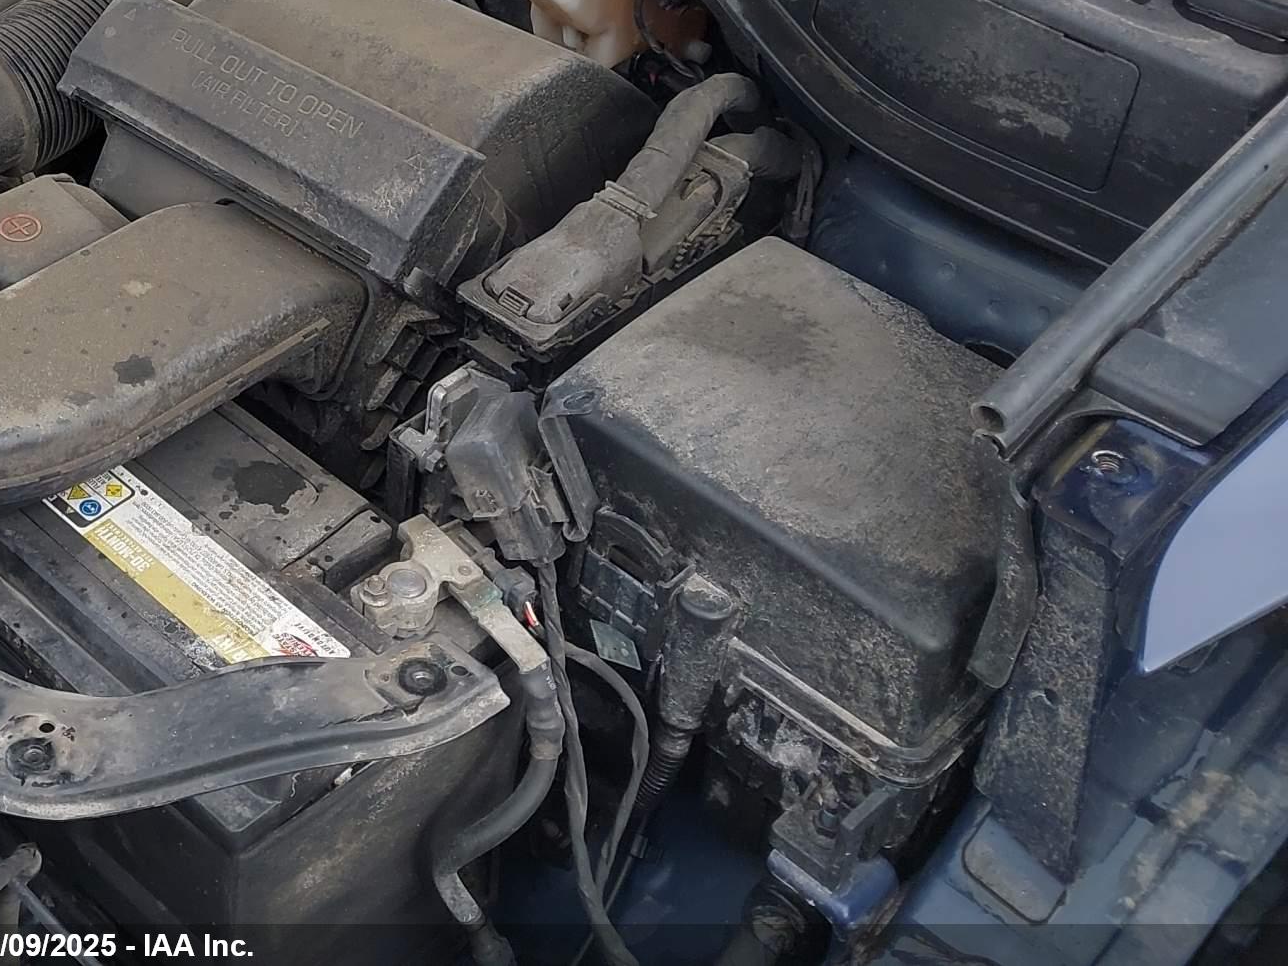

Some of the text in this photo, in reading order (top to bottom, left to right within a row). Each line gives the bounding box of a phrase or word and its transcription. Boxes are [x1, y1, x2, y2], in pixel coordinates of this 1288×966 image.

[169, 28, 365, 140] PULL OUT TO OPEN
[94, 525, 151, 572] 30-MONTH
